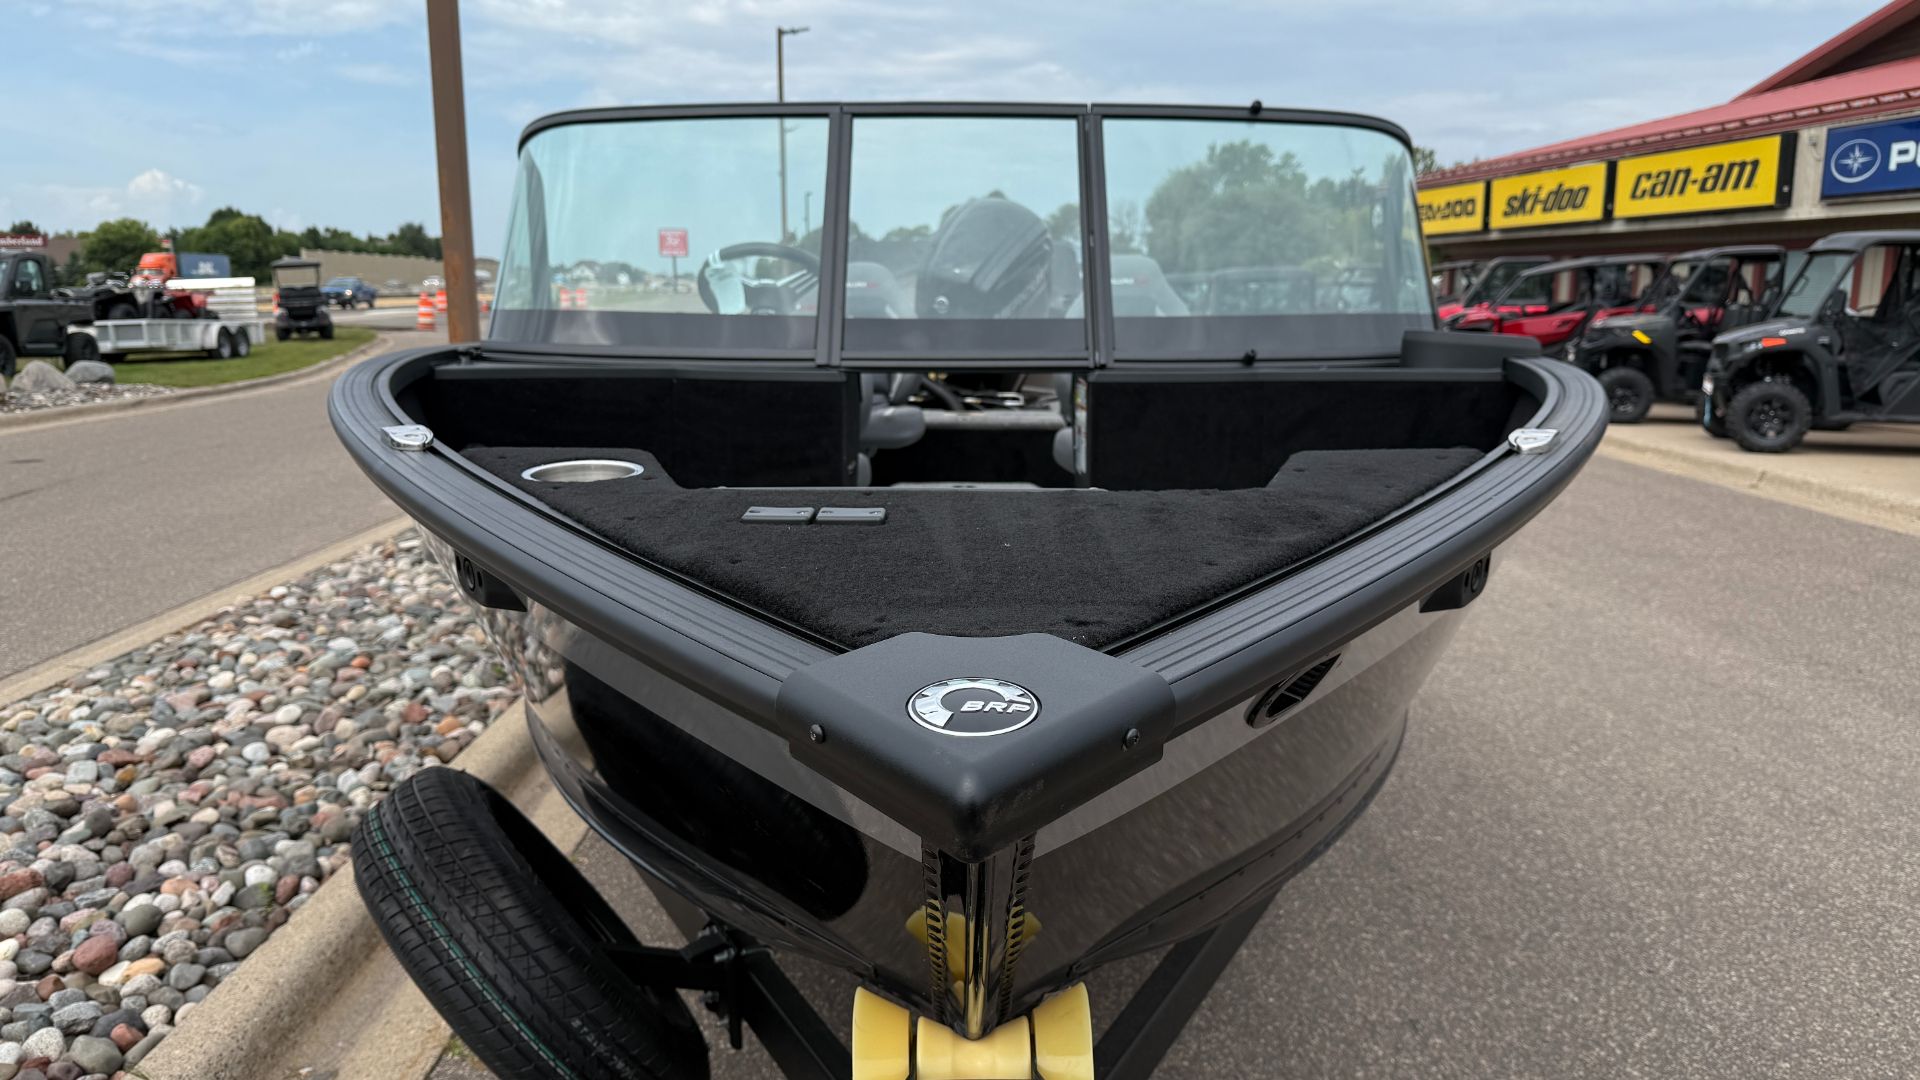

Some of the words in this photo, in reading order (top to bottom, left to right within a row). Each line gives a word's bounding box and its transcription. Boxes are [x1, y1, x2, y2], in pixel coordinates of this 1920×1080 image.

[1888, 140, 1920, 171] P
[1630, 158, 1760, 200] can-am
[1503, 183, 1589, 217] ski-doo
[960, 700, 1031, 713] BRP
